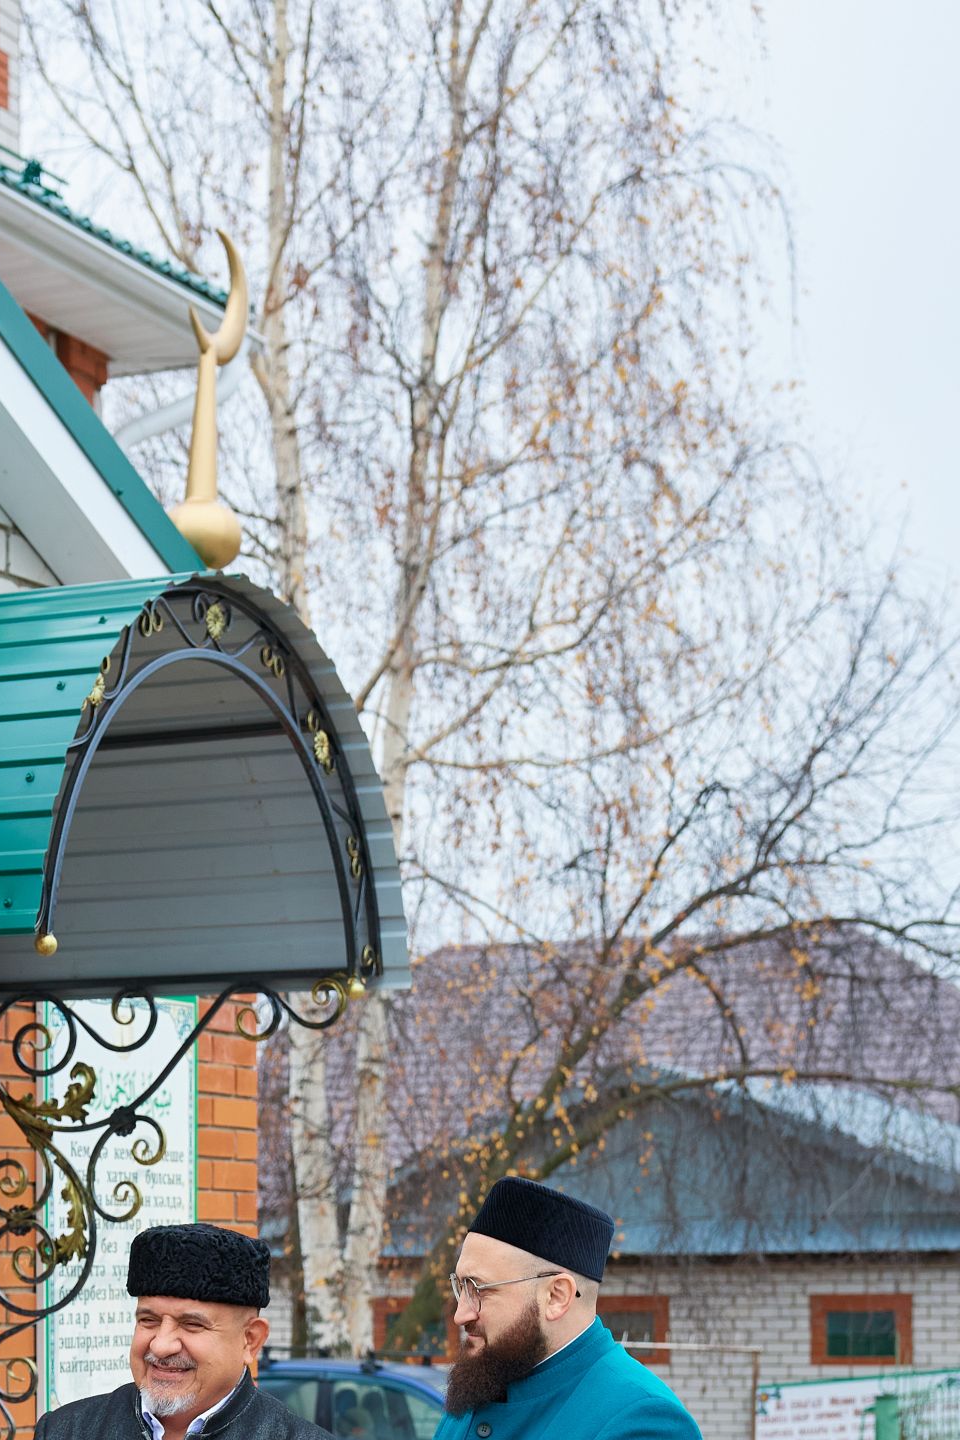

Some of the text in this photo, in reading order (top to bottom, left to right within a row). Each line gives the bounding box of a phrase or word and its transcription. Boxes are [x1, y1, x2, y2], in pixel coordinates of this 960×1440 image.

[161, 1152, 184, 1162] еше
[101, 1239, 117, 1253] без
[59, 1312, 90, 1328] алар
